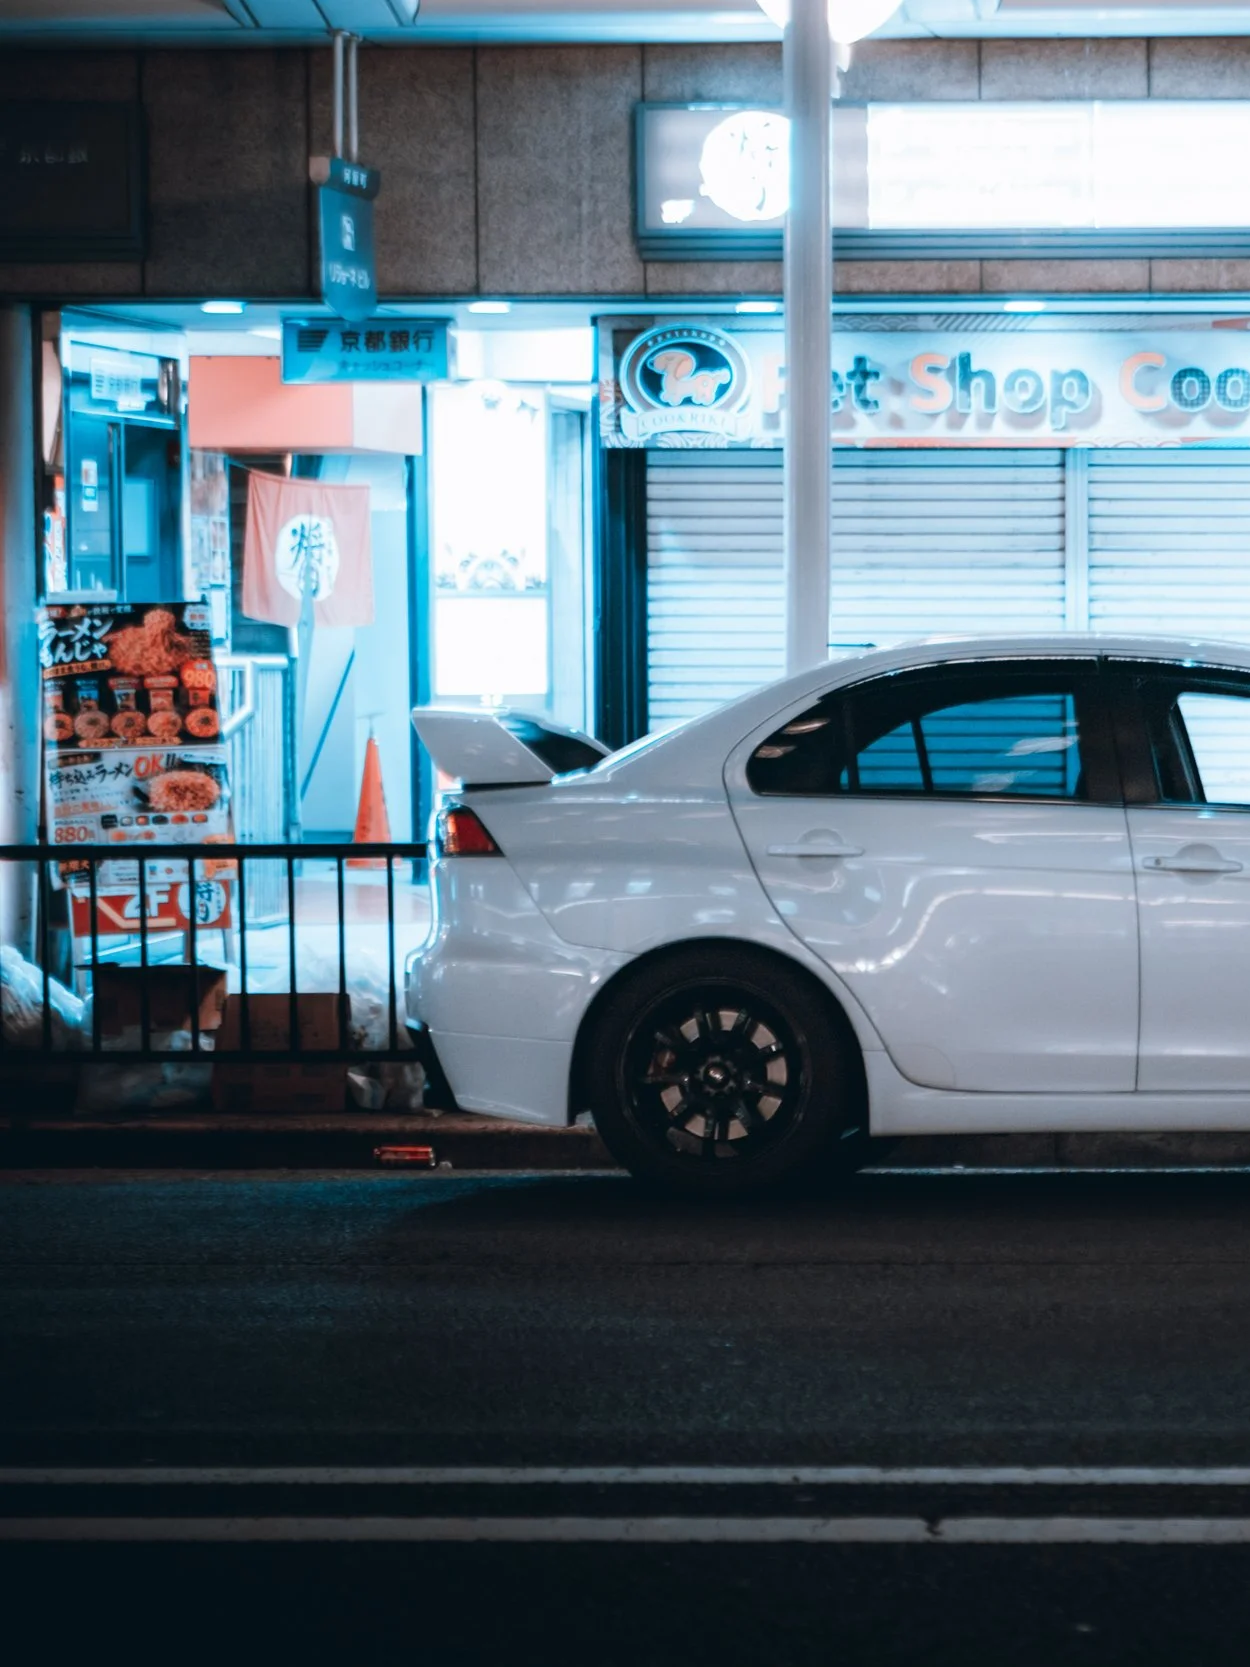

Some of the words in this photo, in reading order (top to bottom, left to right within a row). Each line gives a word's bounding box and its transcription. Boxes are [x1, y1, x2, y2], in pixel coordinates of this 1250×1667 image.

[340, 329, 434, 353] 京都銀行
[909, 351, 1092, 430] Shop
[41, 617, 114, 643] ラーメン
[40, 638, 108, 667] もんじゃ
